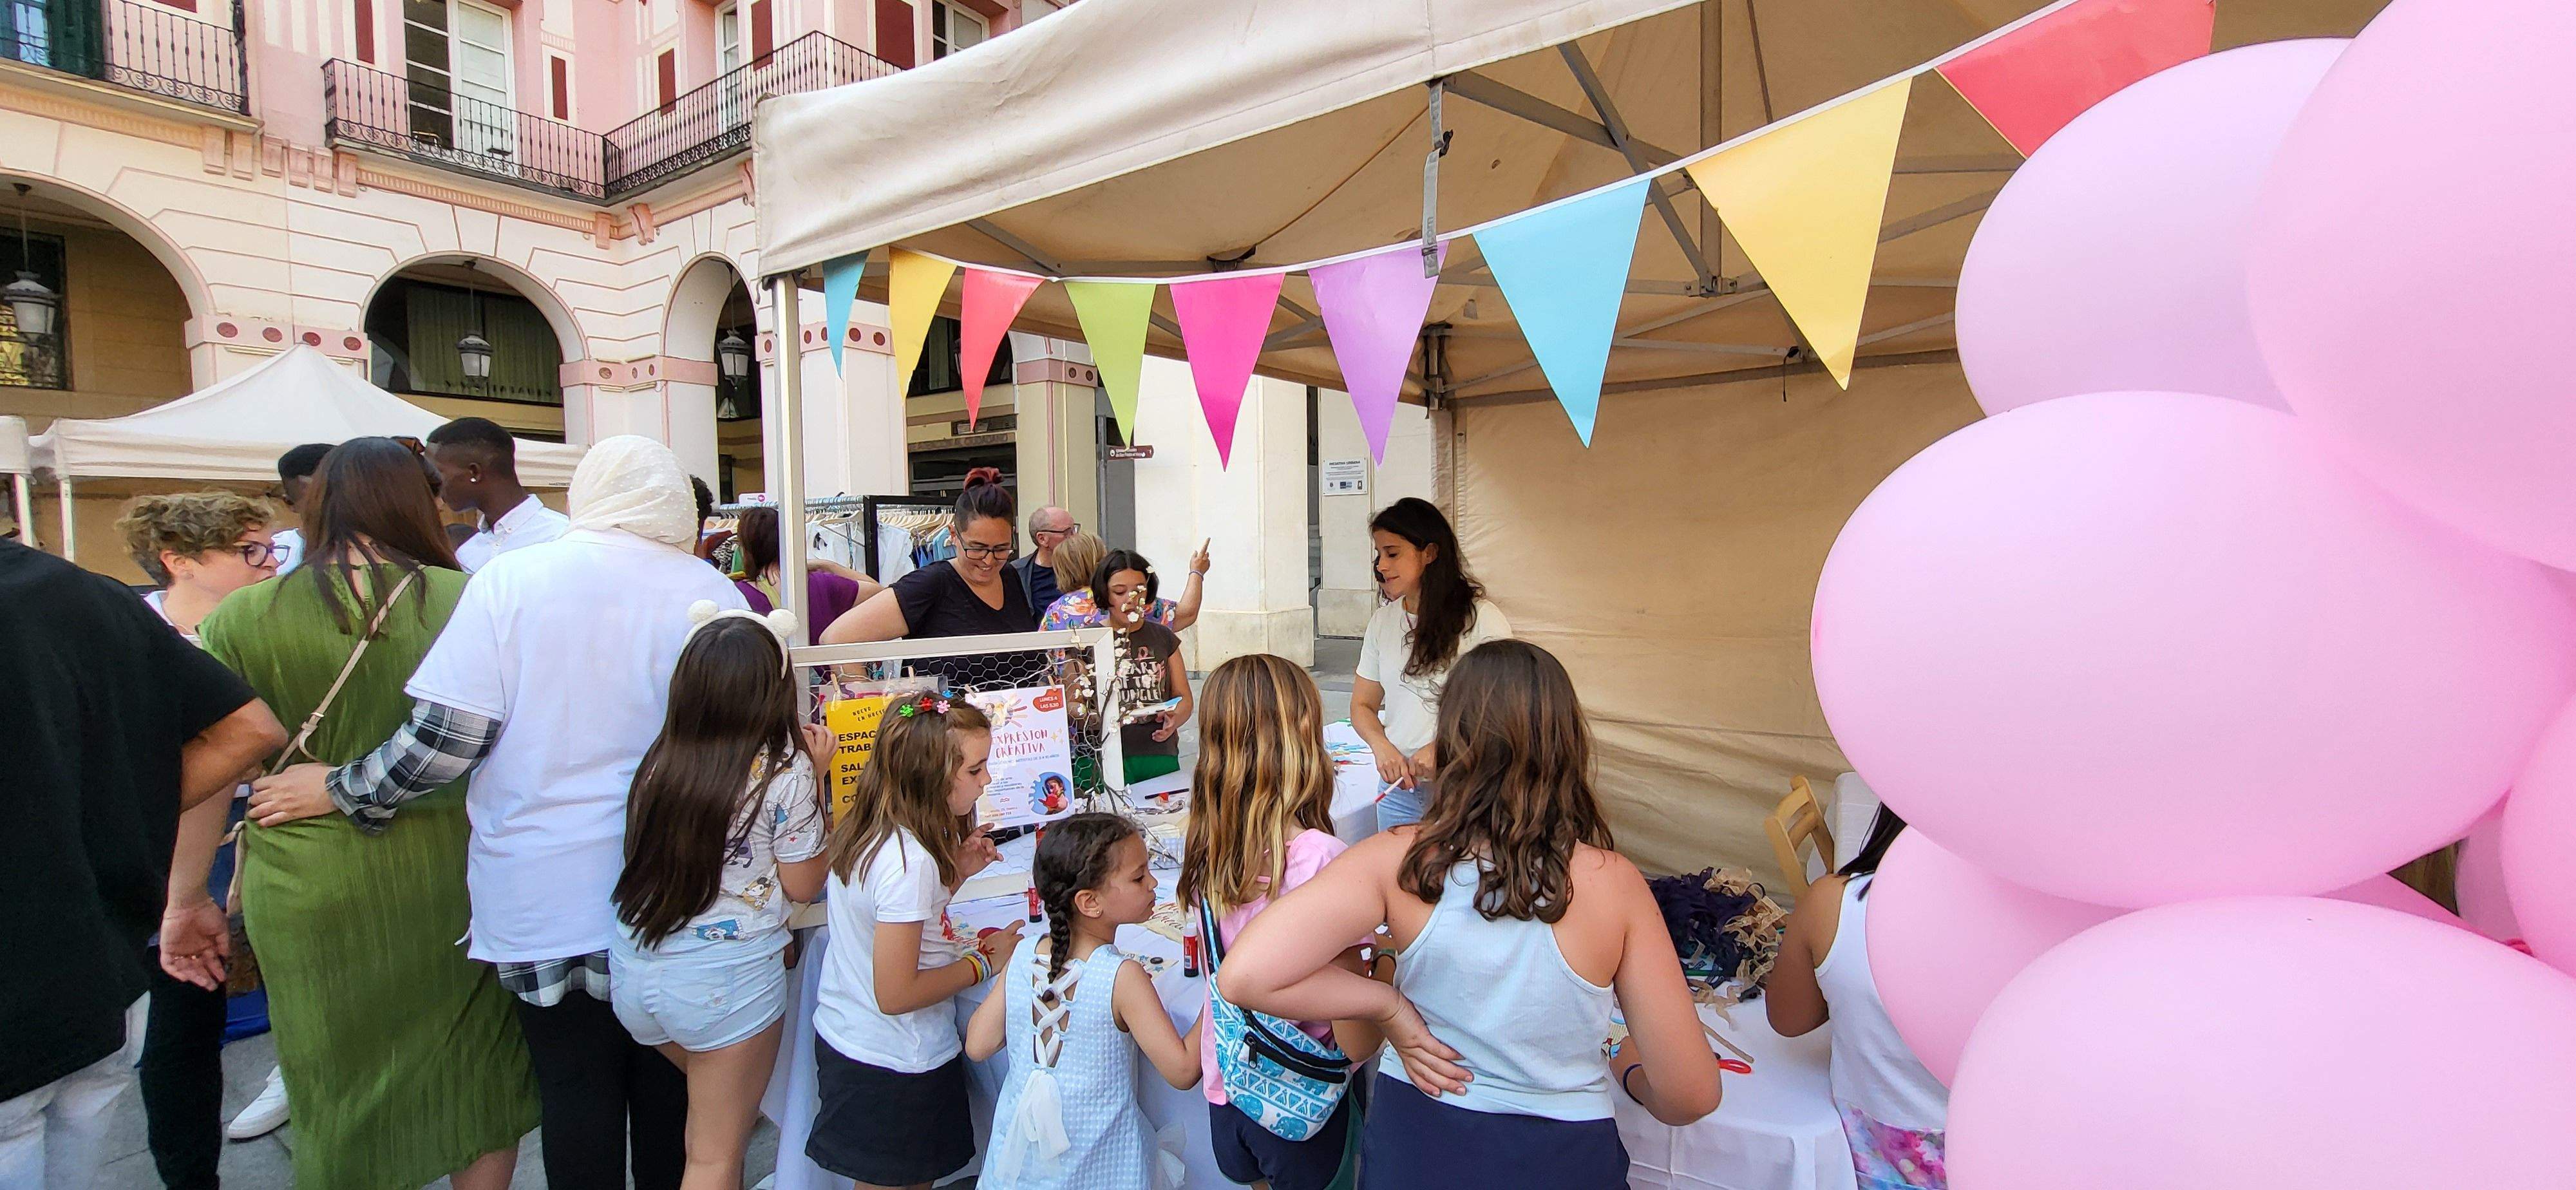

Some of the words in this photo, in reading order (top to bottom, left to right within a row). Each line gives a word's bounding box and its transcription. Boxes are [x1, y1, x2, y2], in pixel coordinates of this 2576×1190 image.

[1132, 674, 1158, 688] TE
[838, 730, 876, 742] ESPAC
[839, 743, 871, 754] TRAB
[996, 742, 1045, 759] CREATIVA
[841, 762, 864, 773] SAL
[842, 776, 858, 785] EX
[842, 795, 857, 804] CO
